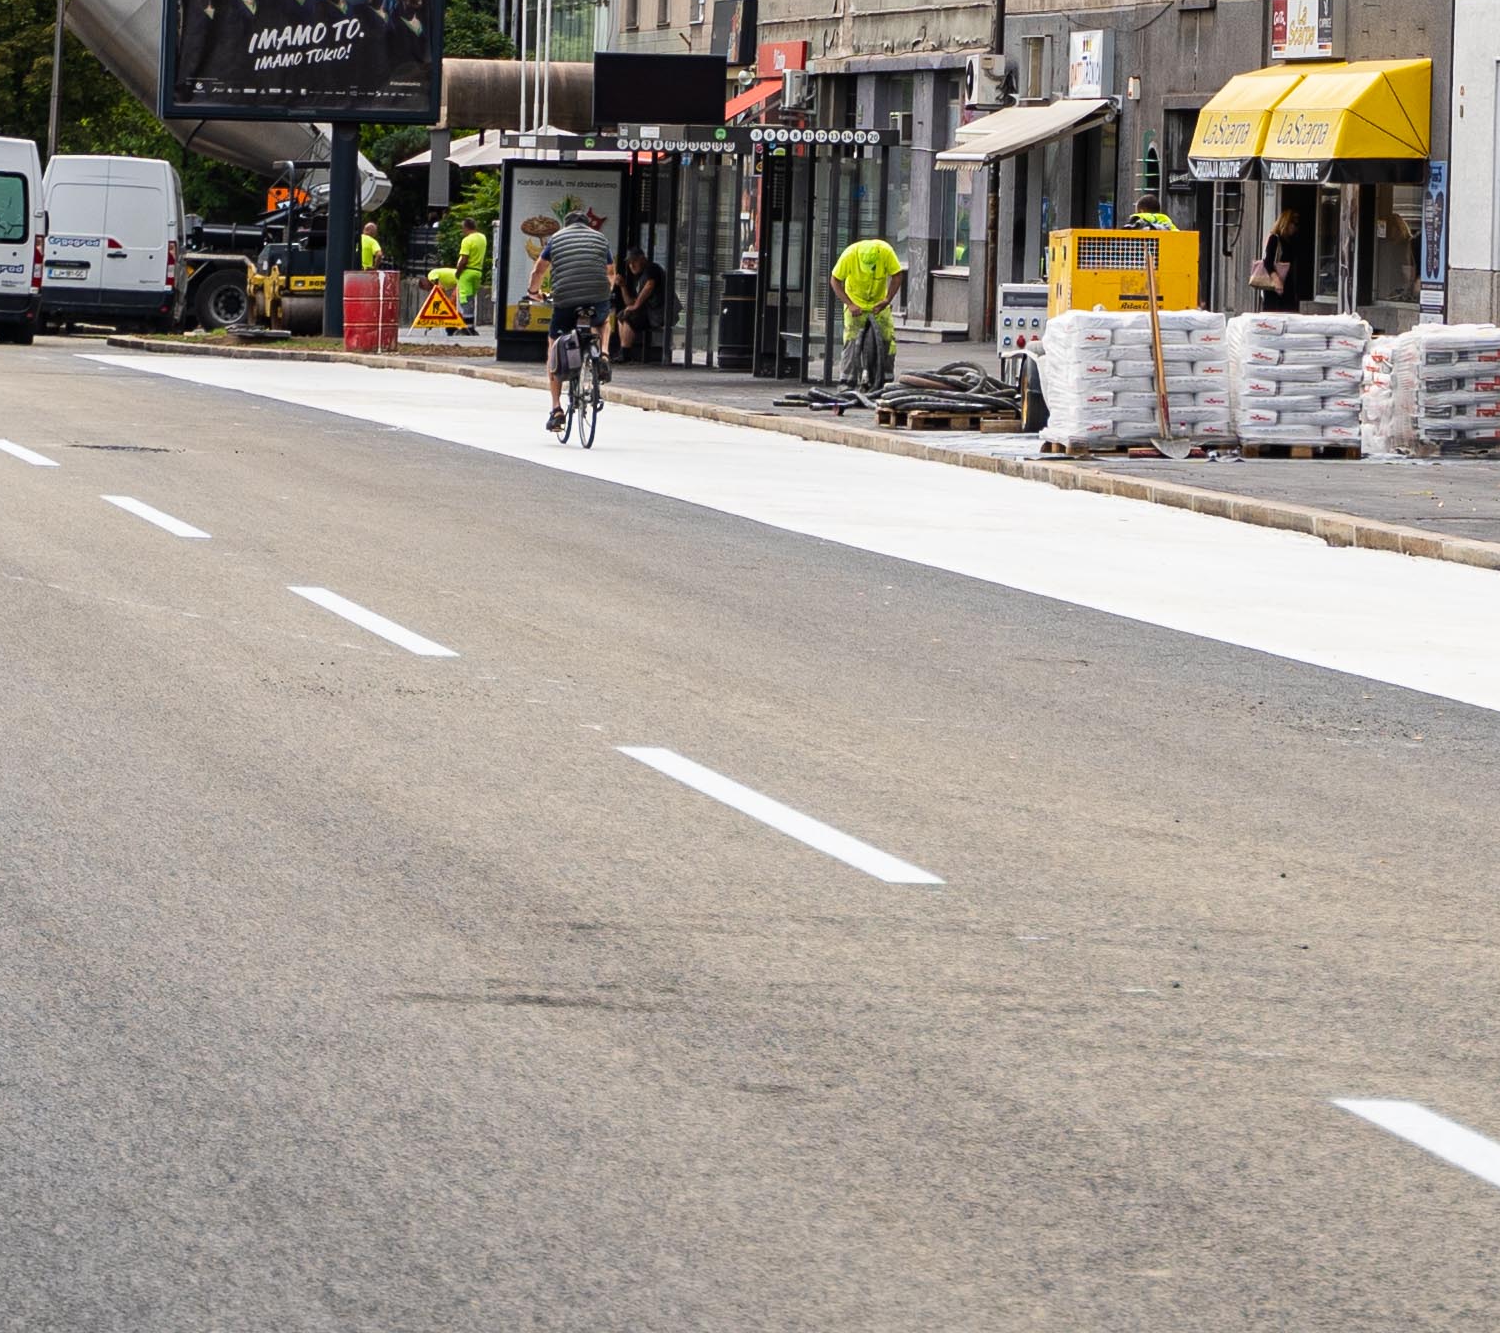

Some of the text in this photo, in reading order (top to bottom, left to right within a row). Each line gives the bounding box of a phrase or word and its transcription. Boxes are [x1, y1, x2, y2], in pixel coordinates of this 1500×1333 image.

[248, 17, 365, 54] IMAMO TO.
[254, 44, 352, 71] IMAMO TOKIO!
[1269, 162, 1319, 180] PRODAJA OBUTVE
